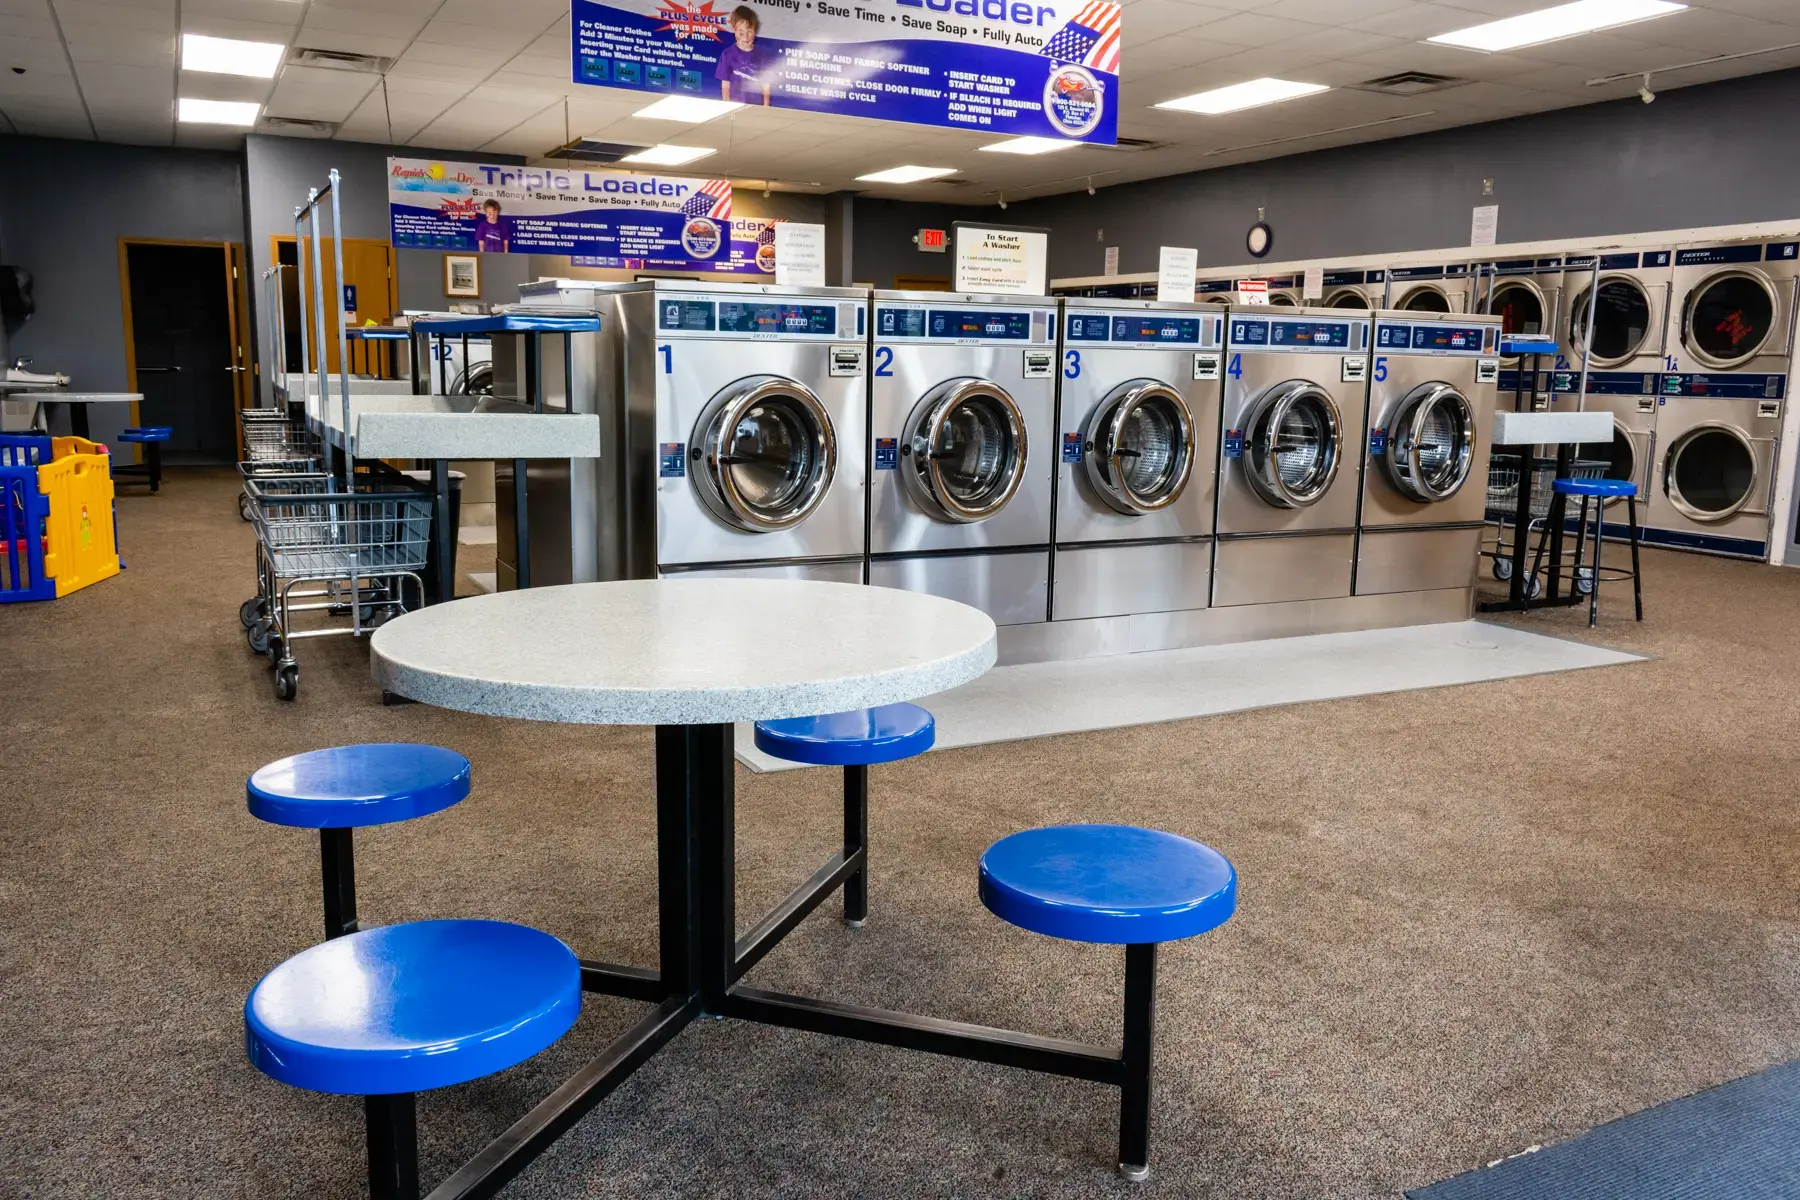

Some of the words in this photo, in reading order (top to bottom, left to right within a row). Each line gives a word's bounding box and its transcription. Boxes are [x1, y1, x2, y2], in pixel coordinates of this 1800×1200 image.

[660, 11, 688, 20] PLUS
[692, 14, 727, 24] CYCLE
[686, 5, 701, 14] the
[896, 0, 1056, 27] oader
[594, 22, 622, 33] Cleaner
[624, 26, 652, 37] Clothes
[692, 25, 718, 34] made
[818, 2, 850, 18] Save
[854, 7, 885, 23] Time
[902, 15, 932, 31] Save
[936, 20, 968, 38] Soap
[983, 28, 1010, 45] Fully
[1014, 32, 1043, 47] Auto
[604, 32, 634, 43] Minutes
[646, 39, 662, 48] your
[664, 40, 683, 50] Wash
[684, 44, 694, 52] by
[674, 30, 688, 38] for
[580, 38, 614, 50] Inserting
[616, 44, 632, 53] your
[634, 45, 650, 54] Card
[652, 48, 675, 58] within
[676, 50, 690, 60] One
[692, 53, 716, 63] Minute
[580, 48, 598, 56] after
[614, 51, 640, 62] Washer
[642, 55, 656, 64] has
[656, 58, 684, 68] started.
[785, 48, 804, 58] PUT
[806, 50, 830, 60] SOAP
[832, 54, 852, 64] AND
[854, 57, 886, 69] FABRIC
[888, 62, 930, 76] SOFTENER
[786, 58, 798, 66] IN
[800, 60, 842, 72] MACHINE
[785, 71, 810, 80] LOAD
[856, 80, 883, 92] CLOSE
[885, 84, 909, 94] DOOR
[911, 86, 941, 98] FIRMLY
[950, 70, 979, 82] INSERT
[980, 74, 1003, 85] CARD
[1004, 77, 1016, 86] TO
[785, 84, 818, 95] SELECT
[820, 88, 846, 99] WASH
[848, 92, 876, 102] CYCLE
[948, 80, 975, 90] START
[976, 83, 1010, 95] WASHER
[948, 102, 966, 112] ADD
[968, 105, 992, 115] WHEN
[994, 107, 1017, 118] LIGHT
[950, 92, 958, 100] IF
[960, 94, 990, 105] BLEACH
[992, 96, 1001, 106] IS
[1002, 98, 1042, 111] REQUIRED
[948, 112, 977, 124] COMES
[979, 116, 991, 124] ON
[392, 165, 425, 180] Rapids
[456, 172, 475, 186] Dry
[479, 166, 570, 192] Triple
[584, 173, 688, 196] Loader
[472, 188, 494, 197] Save
[496, 190, 526, 200] Money
[536, 192, 556, 200] Save
[558, 194, 578, 202] Time
[588, 196, 608, 204] Save
[610, 197, 631, 206] Soap
[641, 199, 660, 208] Fully
[662, 200, 680, 208] Auto
[926, 230, 942, 246] EXIT
[998, 234, 1018, 242] Start
[431, 344, 452, 361] 12
[658, 344, 672, 374] 1
[875, 346, 894, 377] 2
[1064, 350, 1080, 379] 3
[1228, 354, 1242, 380] 4
[1374, 356, 1388, 382] 5
[1660, 398, 1666, 406] B
